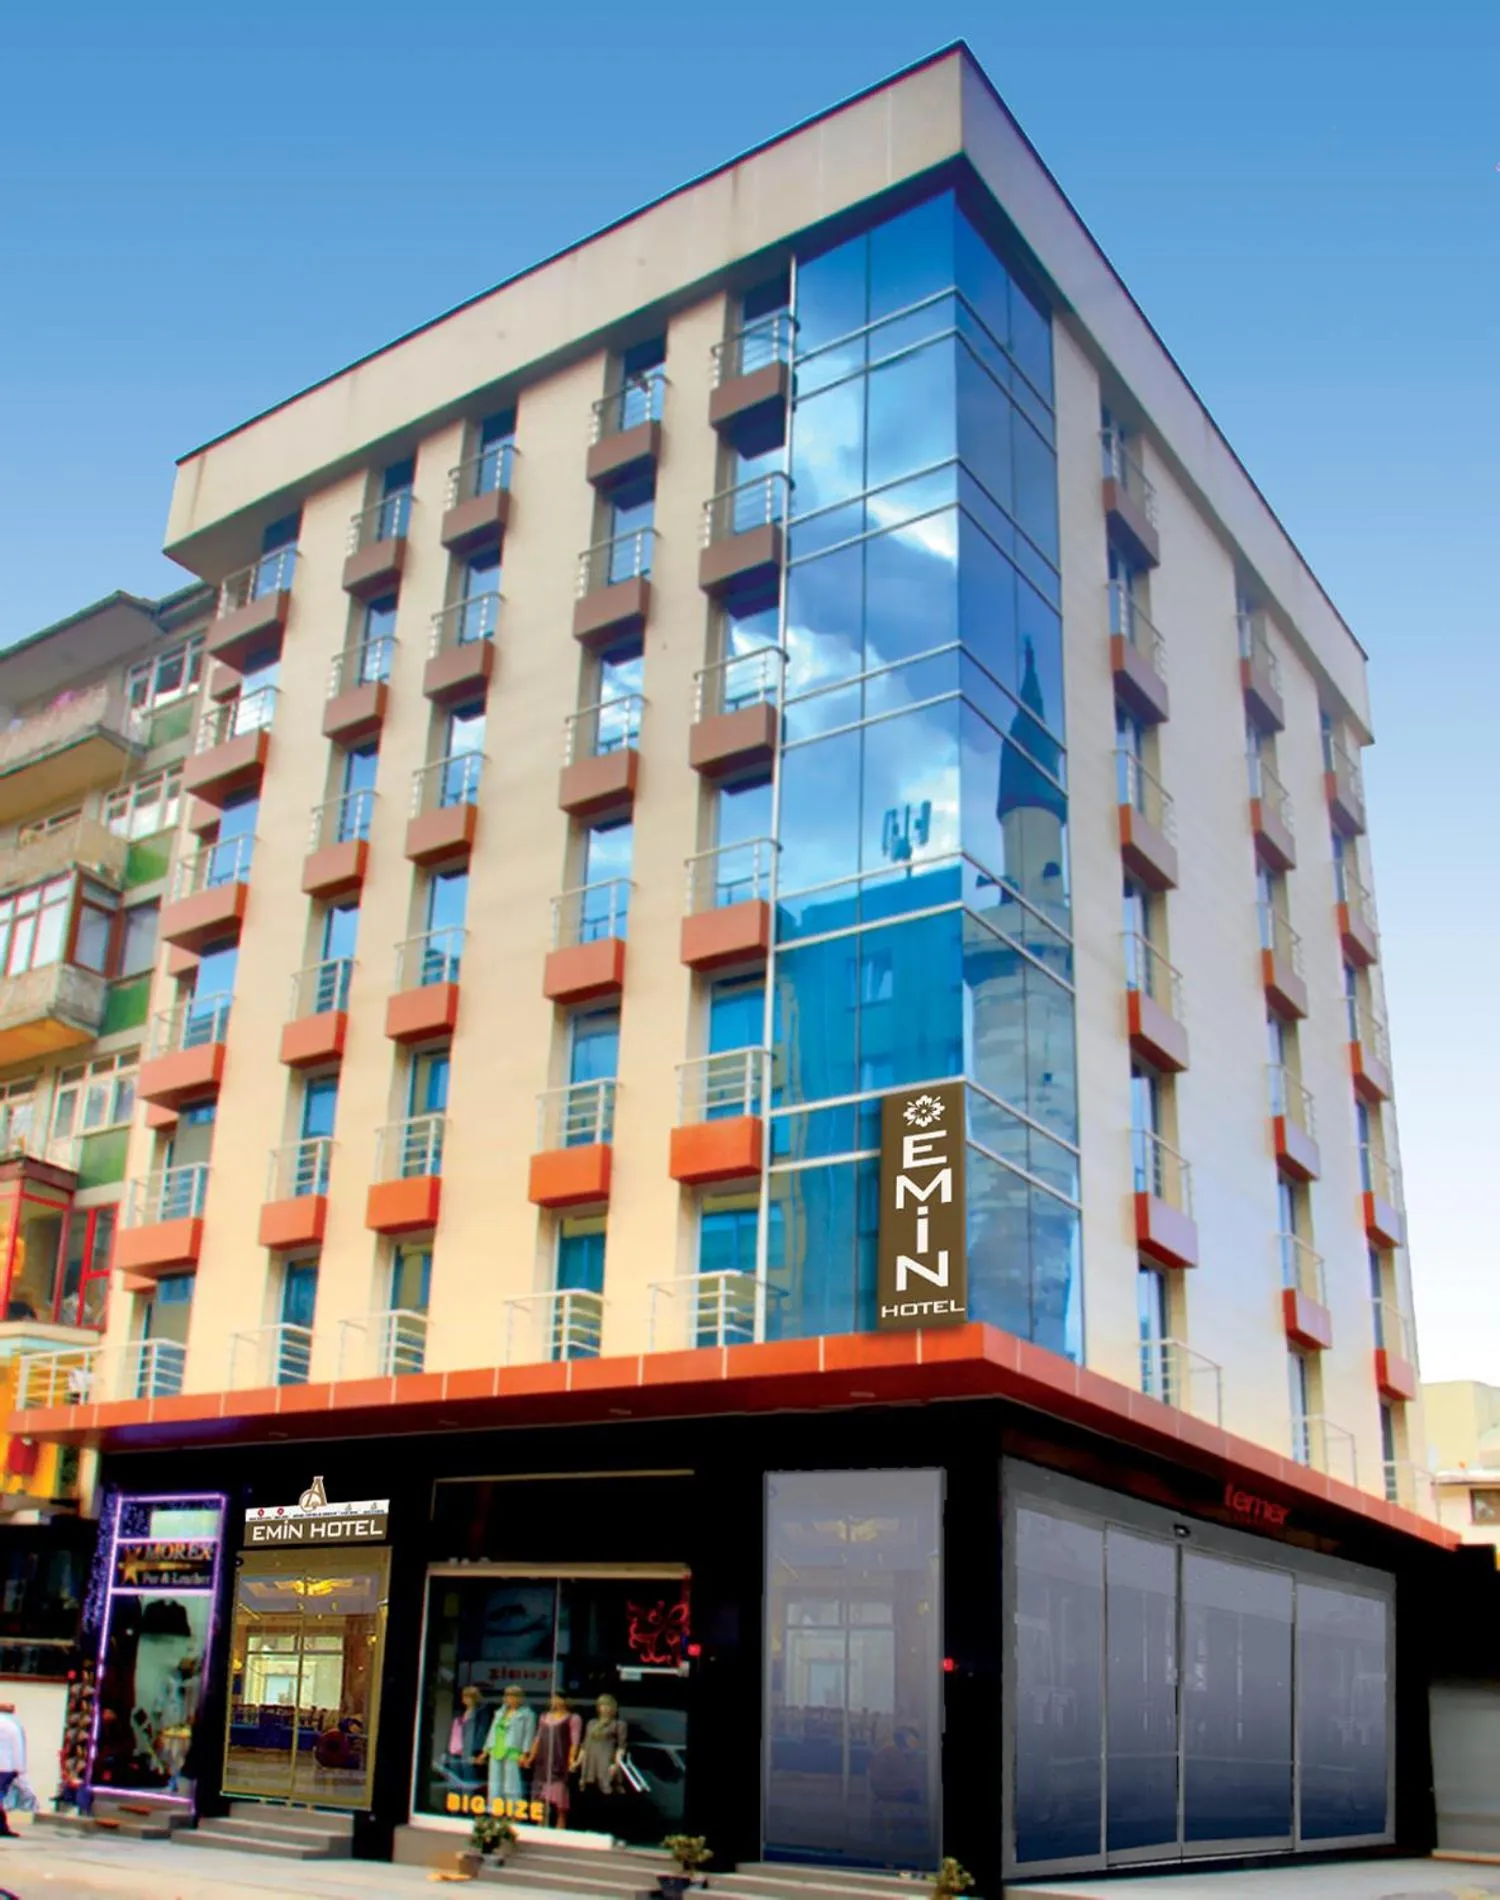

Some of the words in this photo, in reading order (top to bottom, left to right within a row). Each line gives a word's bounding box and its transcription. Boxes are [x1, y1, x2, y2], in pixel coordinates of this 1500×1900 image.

[881, 1299, 966, 1318] HOTEL
[310, 1519, 384, 1539] HOTEL
[446, 1791, 486, 1815] BIG
[491, 1796, 545, 1822] SIZE
